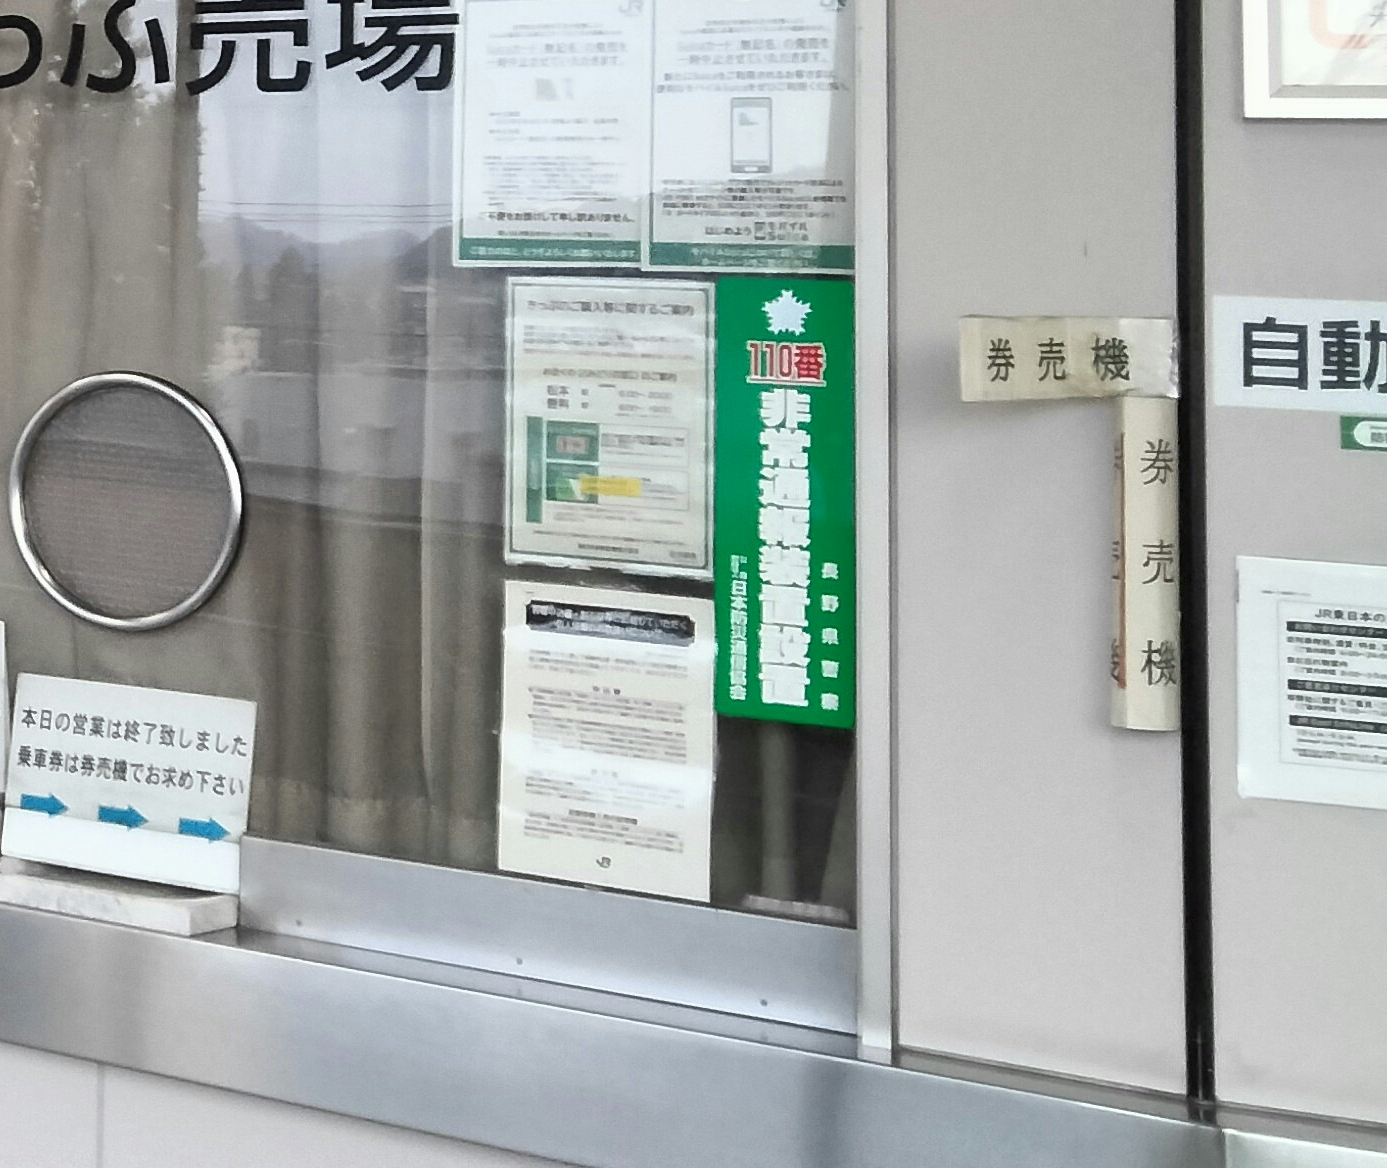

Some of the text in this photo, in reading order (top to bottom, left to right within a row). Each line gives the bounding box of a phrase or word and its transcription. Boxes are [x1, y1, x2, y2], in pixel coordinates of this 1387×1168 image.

[747, 341, 827, 381] 110番
[987, 336, 1131, 384] 券売機
[1140, 438, 1178, 687] 券売機
[20, 707, 248, 758] 本日の営業は終了致しました
[16, 745, 245, 797] 乗車券は券売機でお求め下さい
